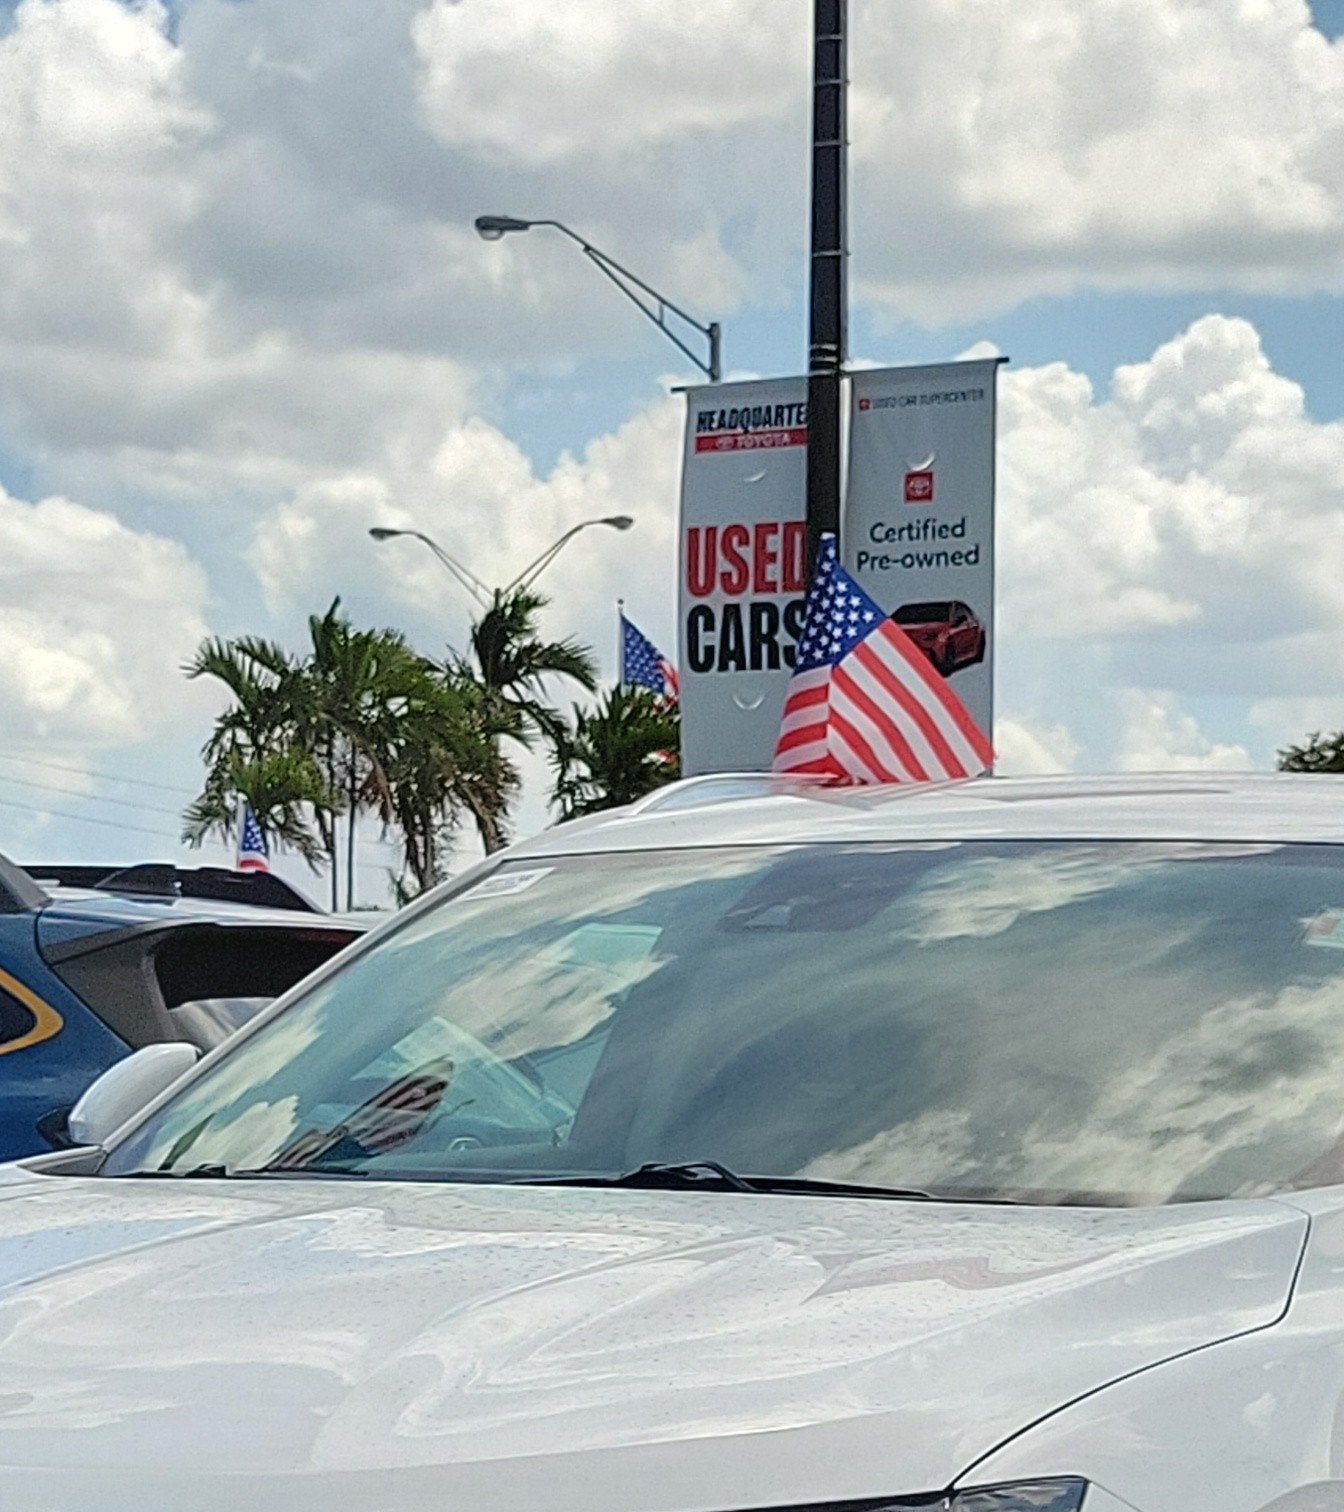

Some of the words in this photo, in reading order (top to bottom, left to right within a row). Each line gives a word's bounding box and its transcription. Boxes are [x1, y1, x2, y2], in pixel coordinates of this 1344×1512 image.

[696, 403, 807, 433] HEADQUARTE
[869, 515, 966, 543] Certified
[688, 522, 806, 597] USED
[856, 543, 980, 573] Pre-owned
